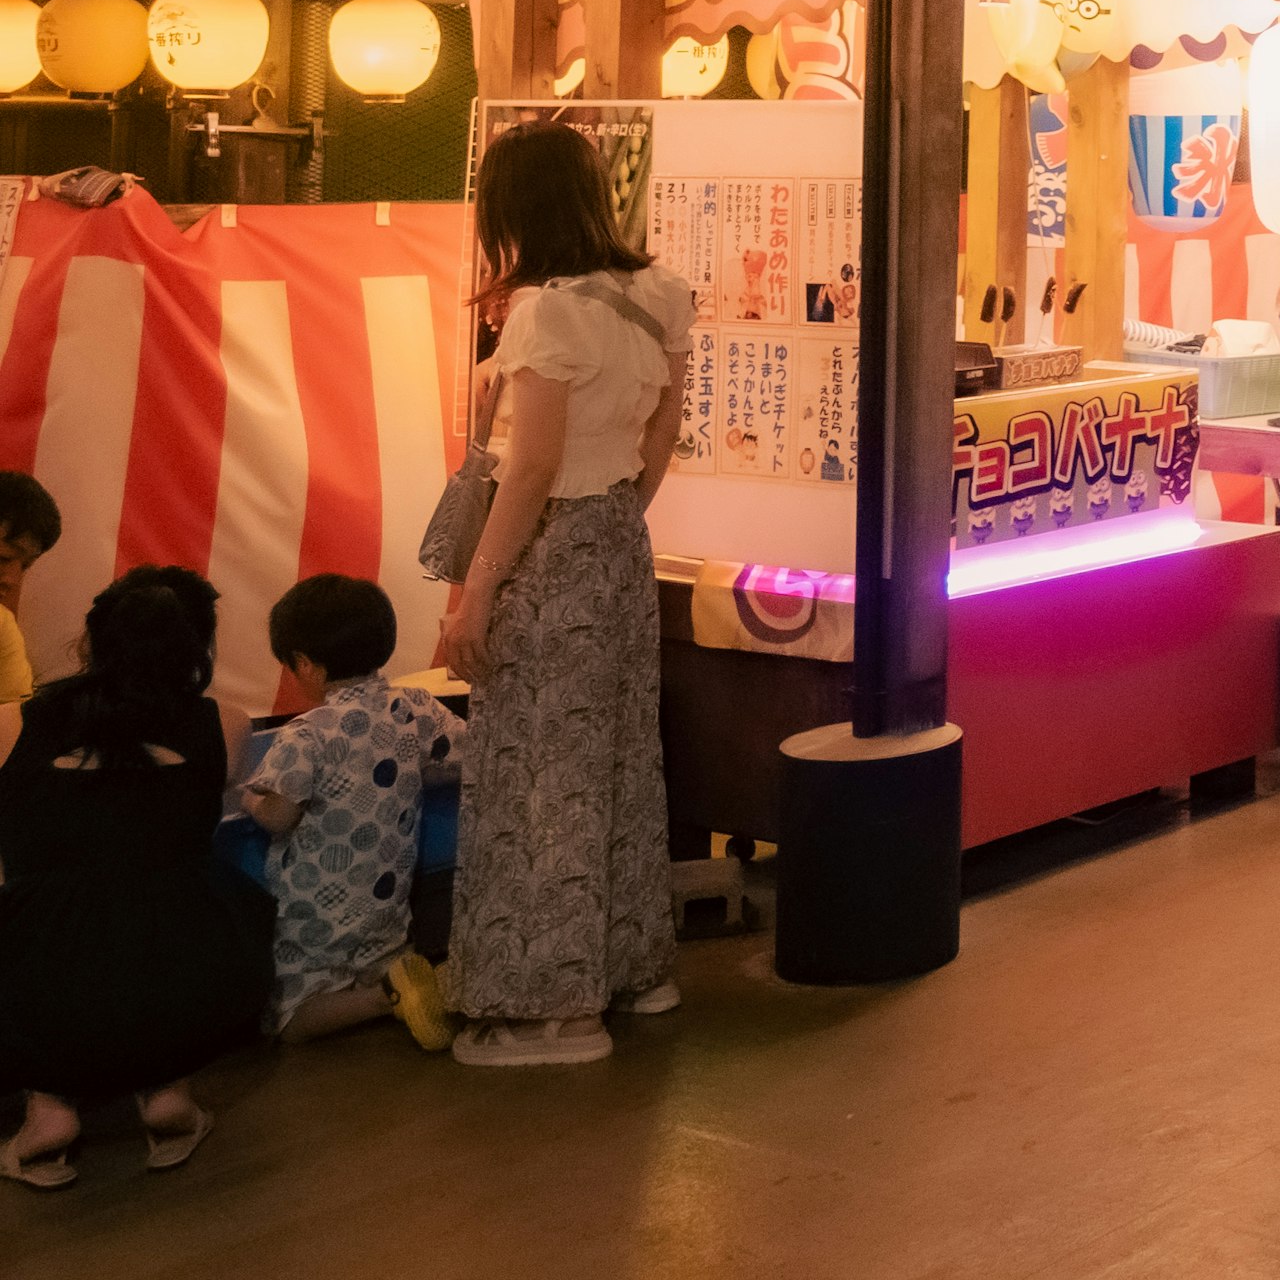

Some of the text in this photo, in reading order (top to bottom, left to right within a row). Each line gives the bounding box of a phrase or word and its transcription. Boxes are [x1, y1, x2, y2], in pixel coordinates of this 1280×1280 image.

[666, 182, 676, 204] 2つ
[678, 182, 688, 204] 1つ
[703, 182, 717, 217] 射的
[744, 183, 752, 223] クルクル
[1172, 123, 1241, 211] 氷
[703, 260, 712, 284] 3発
[768, 183, 790, 316] わたあめ作り
[727, 342, 740, 427] あそべるよ
[743, 343, 756, 428] こうかんで
[772, 344, 788, 473] ゆうぎチケット
[819, 385, 830, 439] えらんでね
[831, 345, 843, 434] とれたぶんから
[953, 384, 1191, 504] チョコバナナ
